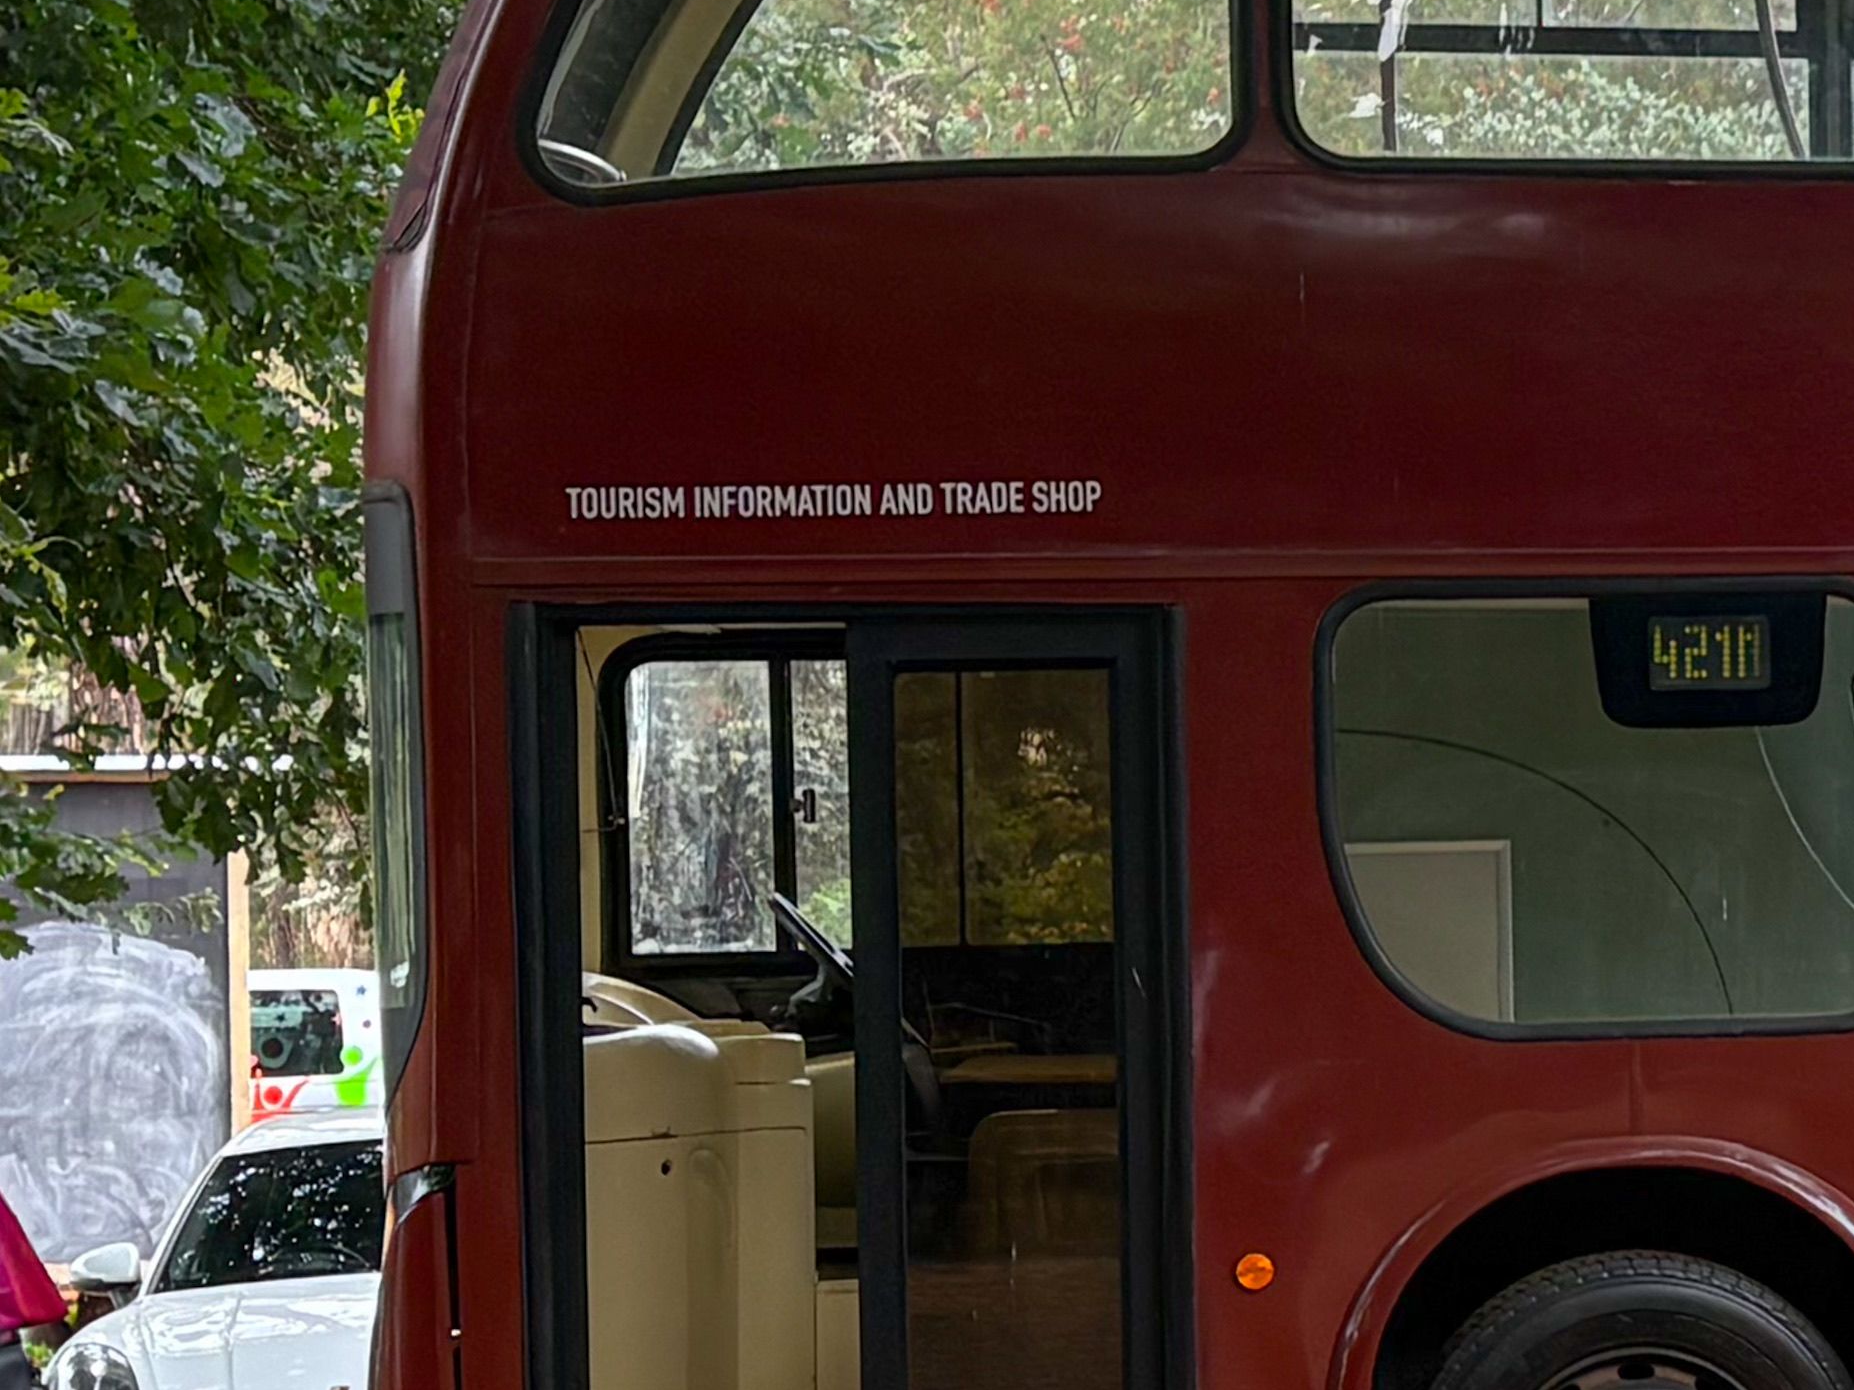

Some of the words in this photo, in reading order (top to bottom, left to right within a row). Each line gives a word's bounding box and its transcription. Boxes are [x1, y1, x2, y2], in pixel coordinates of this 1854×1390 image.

[565, 486, 685, 520] TOURISM
[693, 483, 873, 519] INFORMATION
[879, 482, 934, 516] AND
[939, 480, 1025, 515] TRADE
[1031, 479, 1102, 513] SHOP
